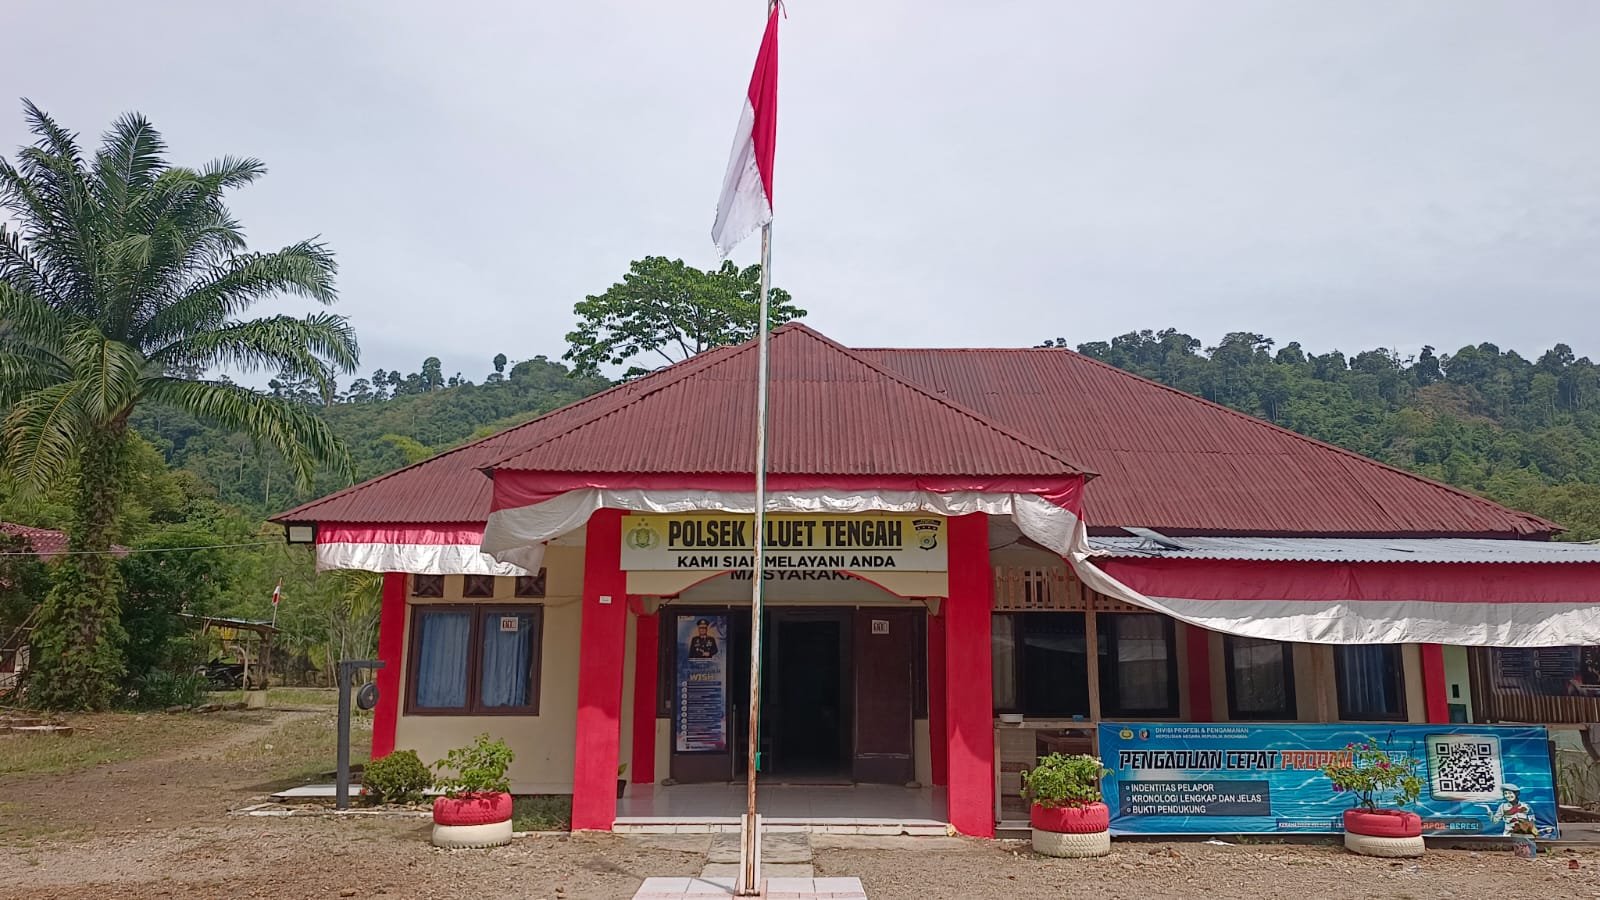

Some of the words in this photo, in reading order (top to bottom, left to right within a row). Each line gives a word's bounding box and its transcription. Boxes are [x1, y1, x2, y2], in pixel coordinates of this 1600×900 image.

[669, 520, 745, 547] POLSEK
[823, 520, 902, 547] TENGAH
[677, 556, 718, 567] KAMI
[765, 556, 845, 567] MELAYANI
[850, 556, 896, 567] ANDA
[1118, 750, 1222, 770] PENGADUAN
[1226, 750, 1277, 770] CEPAT
[1131, 784, 1176, 792] INDENTITAS
[1132, 795, 1178, 803] KRONOLOGI
